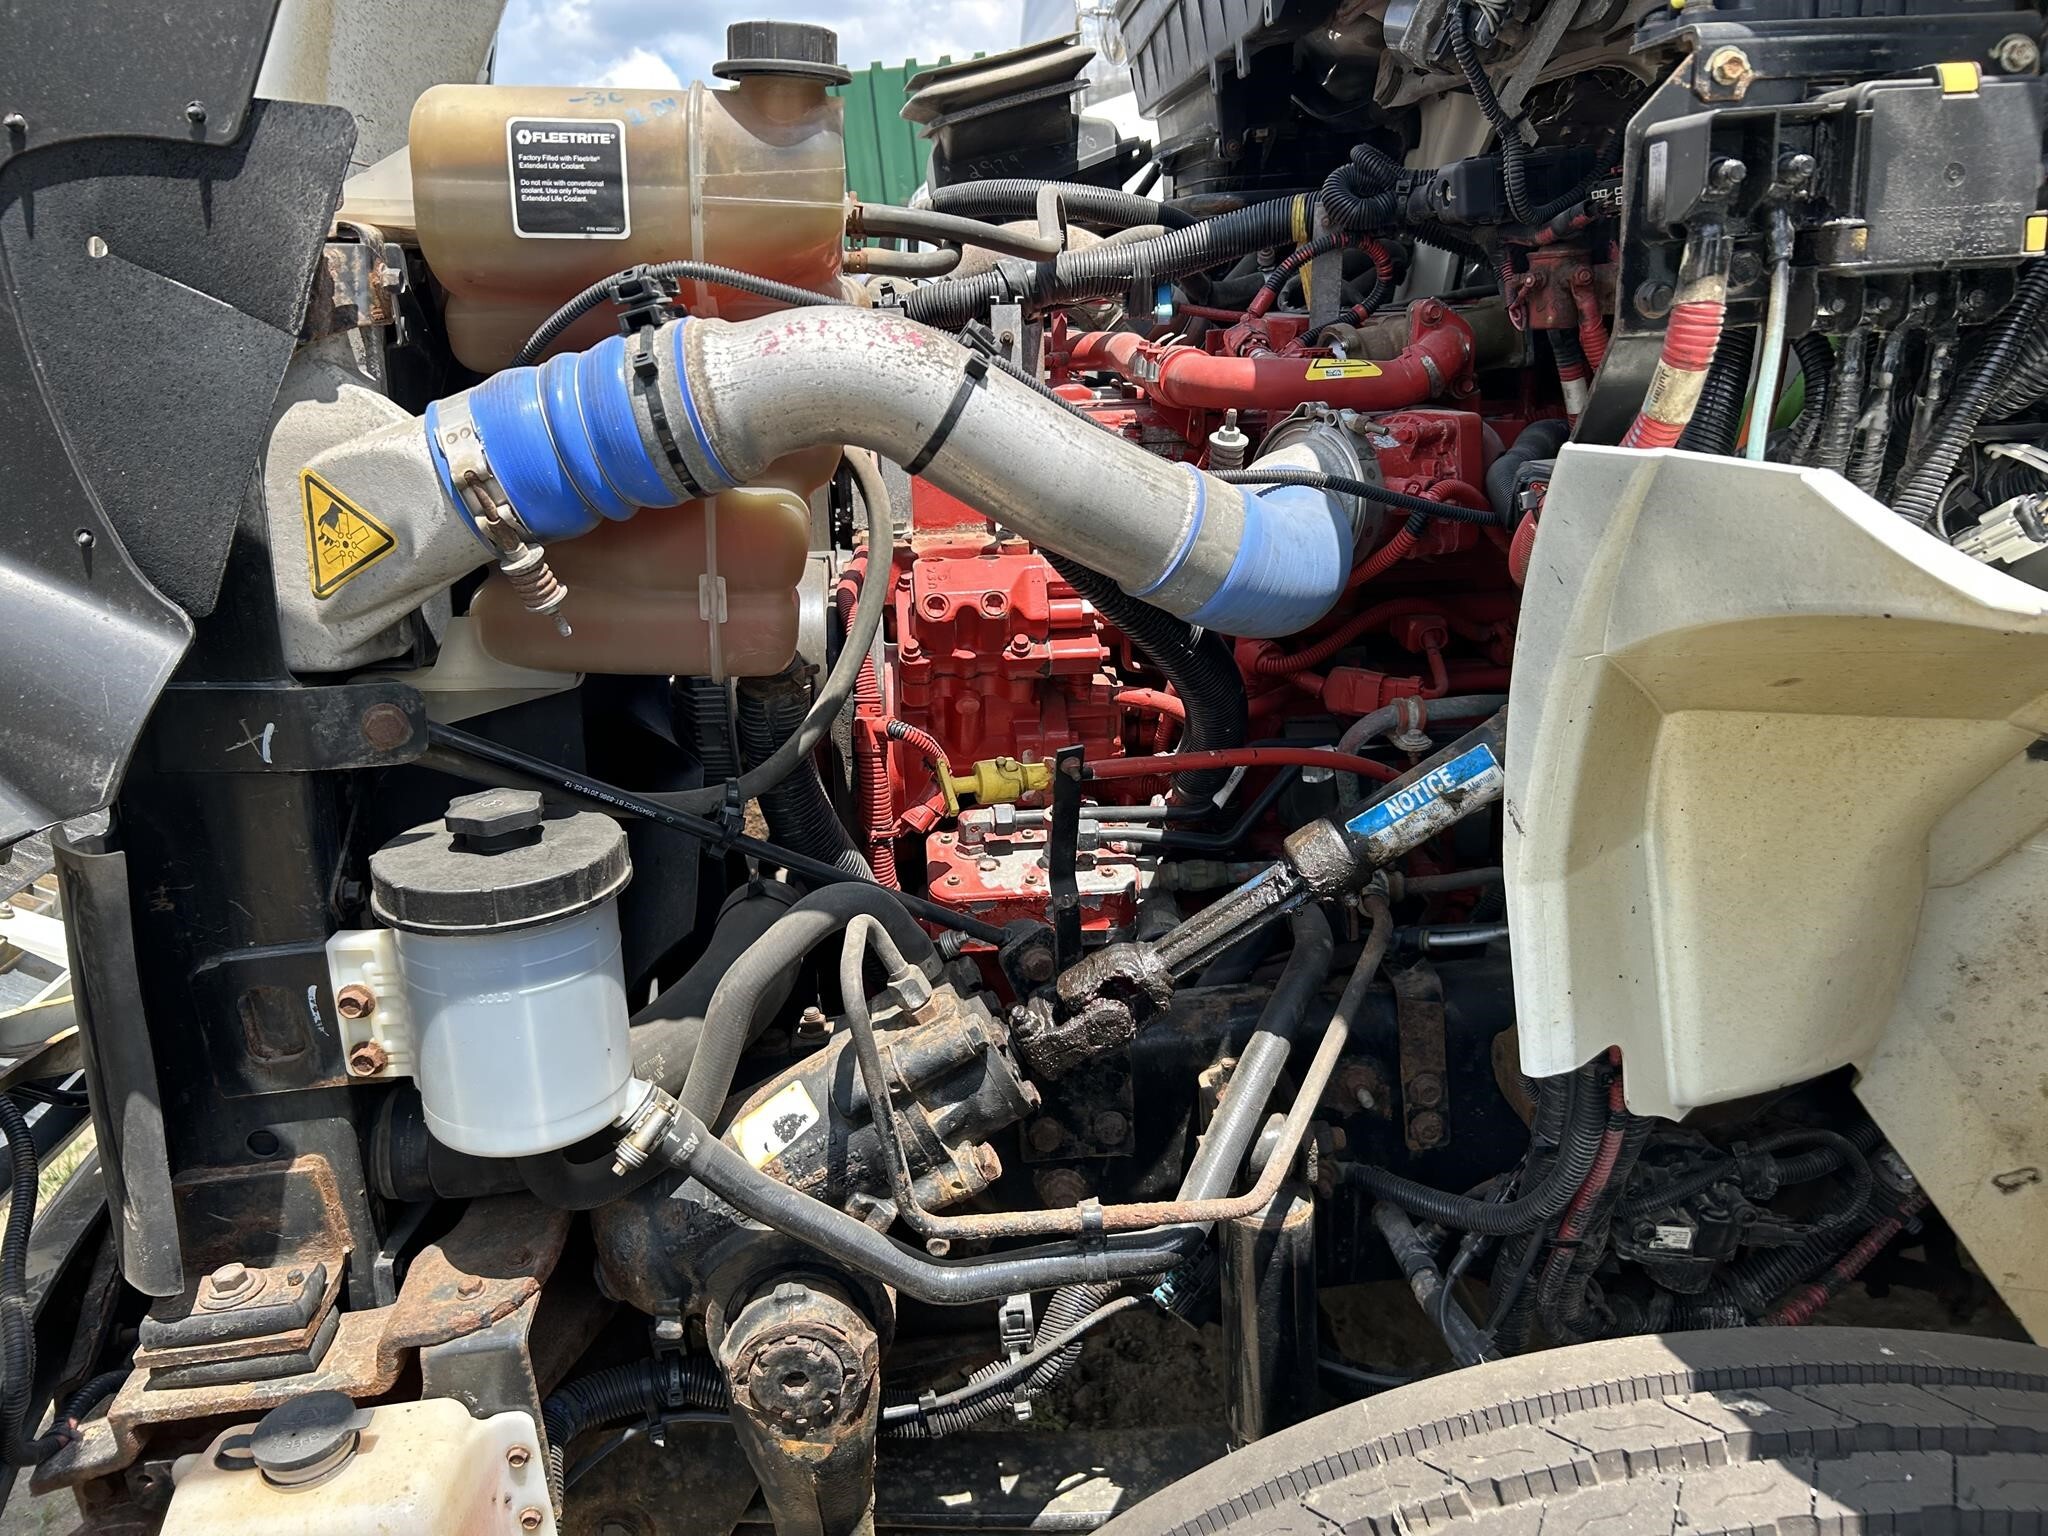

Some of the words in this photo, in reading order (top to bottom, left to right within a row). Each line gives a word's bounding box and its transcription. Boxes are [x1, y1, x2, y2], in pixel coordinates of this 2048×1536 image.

[518, 154, 541, 163] Factory
[542, 154, 559, 162] Filled
[560, 154, 573, 162] with
[561, 162, 586, 170] Coolant.
[559, 188, 572, 196] only
[1384, 767, 1456, 820] NOTICE
[480, 992, 512, 1004] COLD
